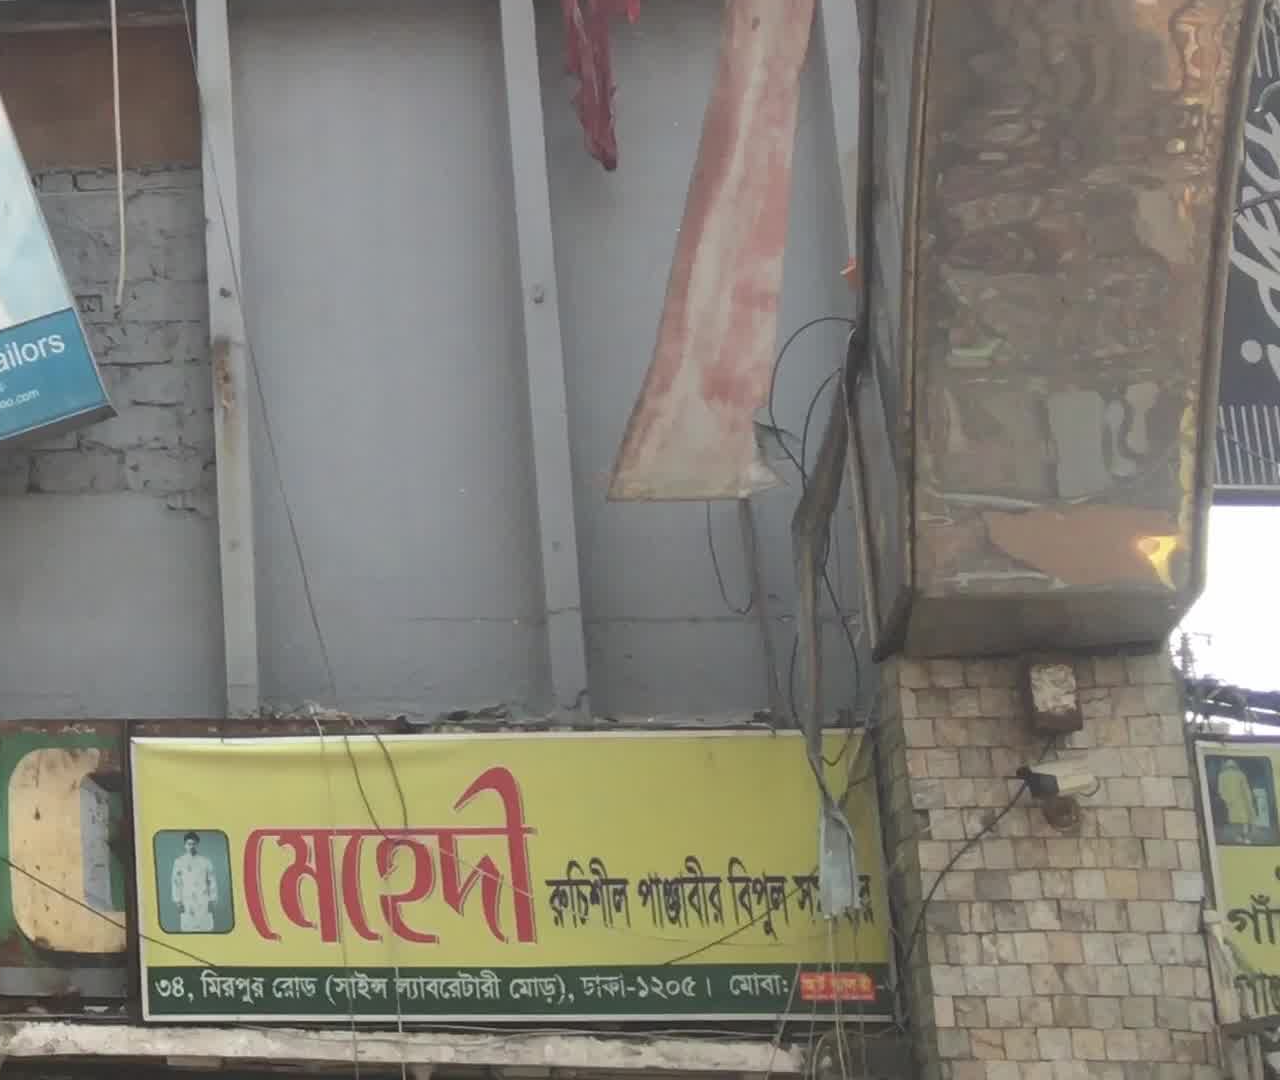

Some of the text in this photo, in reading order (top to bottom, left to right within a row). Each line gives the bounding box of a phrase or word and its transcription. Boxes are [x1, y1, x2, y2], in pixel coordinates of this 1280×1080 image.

[242, 766, 538, 945] মেহেদী
[545, 857, 630, 928] রুচিশীল
[638, 855, 725, 928] পাঞ্জাবীর
[727, 856, 789, 939] বিপুল
[155, 976, 194, 1002] ৩৪,
[201, 970, 264, 1004] মিরপুর
[273, 976, 318, 1000] রোড
